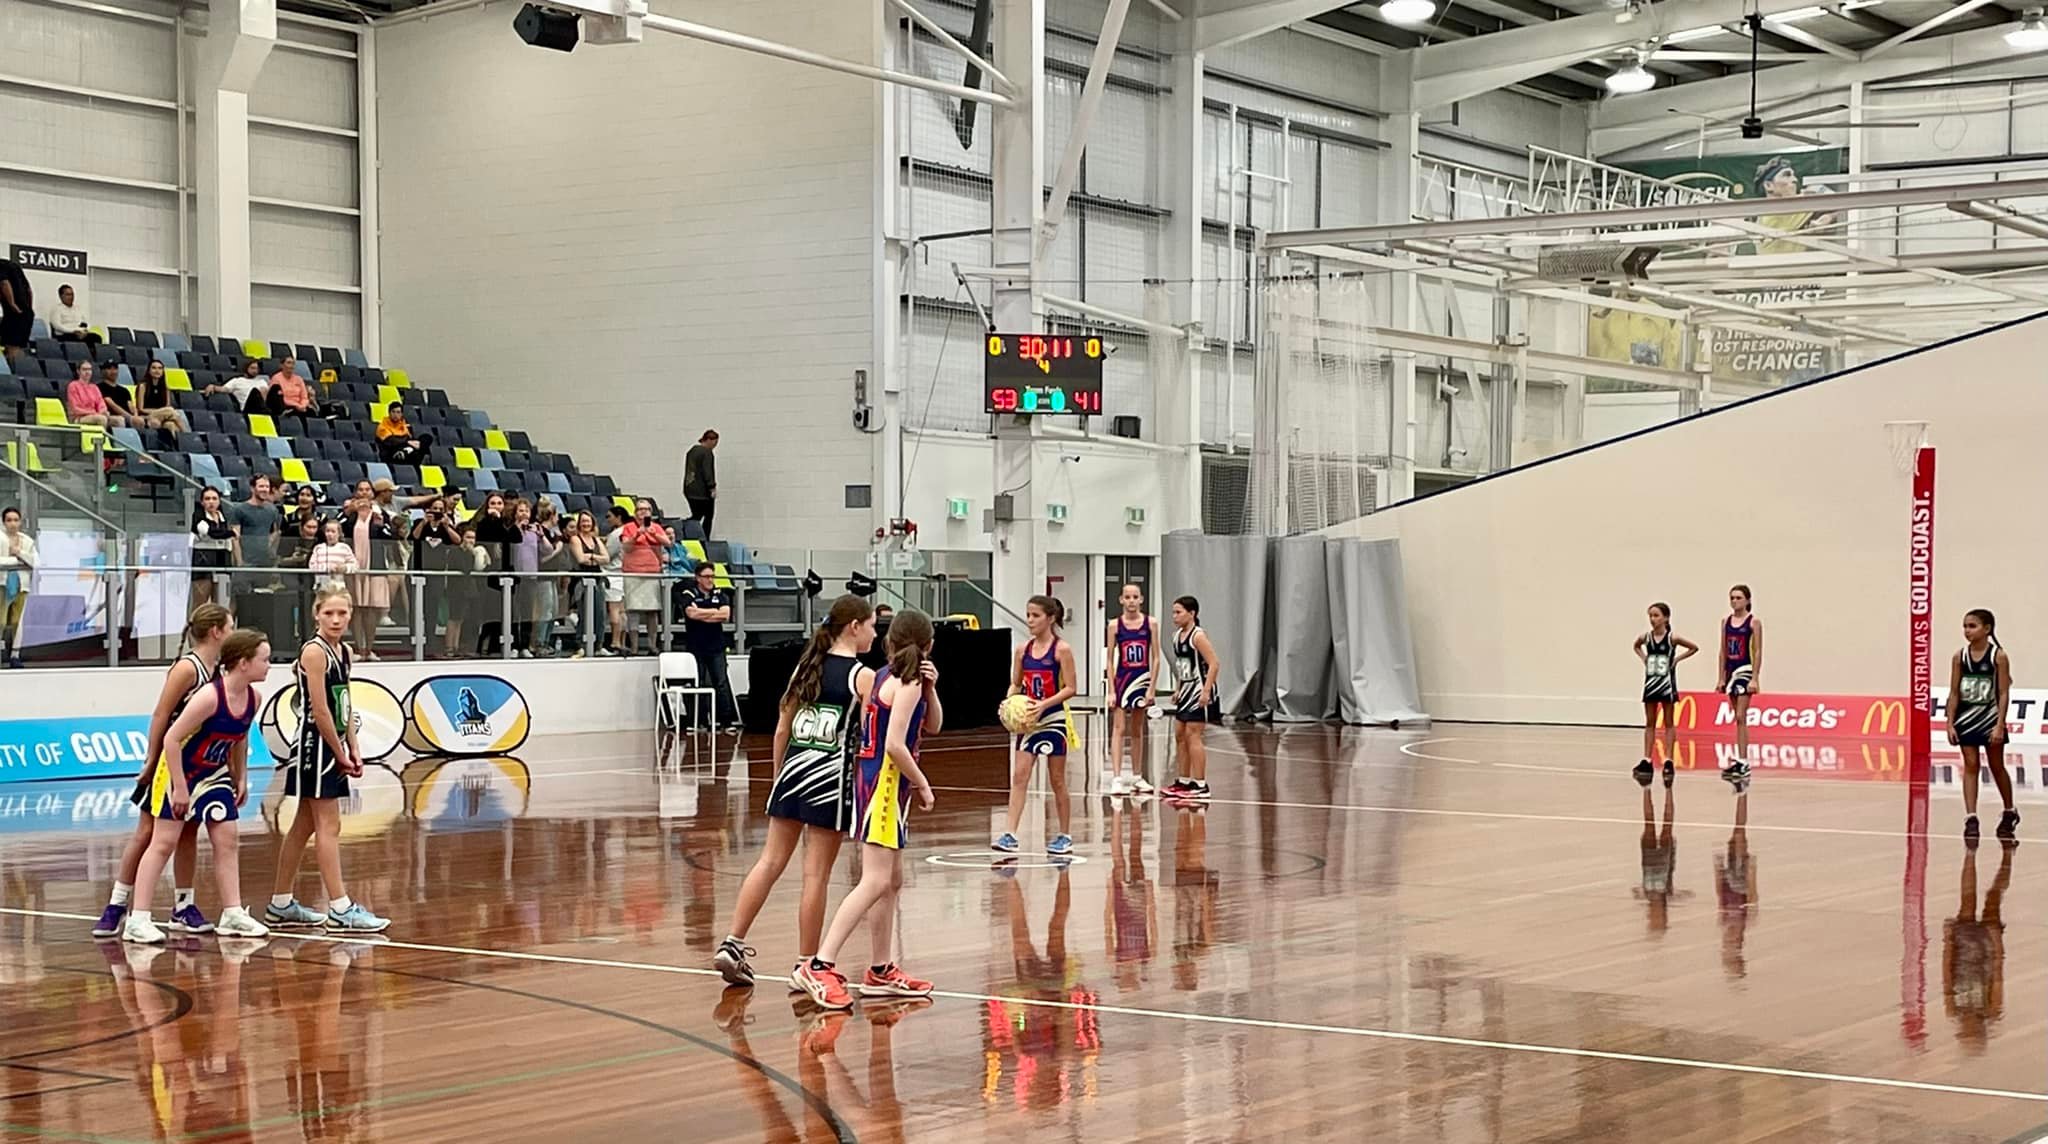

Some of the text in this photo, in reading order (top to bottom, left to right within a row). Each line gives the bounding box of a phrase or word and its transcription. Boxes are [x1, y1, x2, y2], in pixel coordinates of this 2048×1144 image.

[18, 250, 79, 270] STAND 1
[1734, 288, 1826, 304] RONGEST
[988, 336, 1001, 355] 0
[1087, 338, 1101, 357] 0
[1732, 351, 1822, 371] CHANGE
[992, 389, 1017, 409] 53
[1074, 391, 1099, 410] 41
[1911, 491, 1930, 711] AUSTRALIA'S GOLDCOAST.
[1126, 645, 1144, 663] GD
[1715, 702, 1838, 729] Macca's
[791, 706, 841, 747] GD
[35, 742, 64, 767] OF
[70, 731, 148, 764] GOLD
